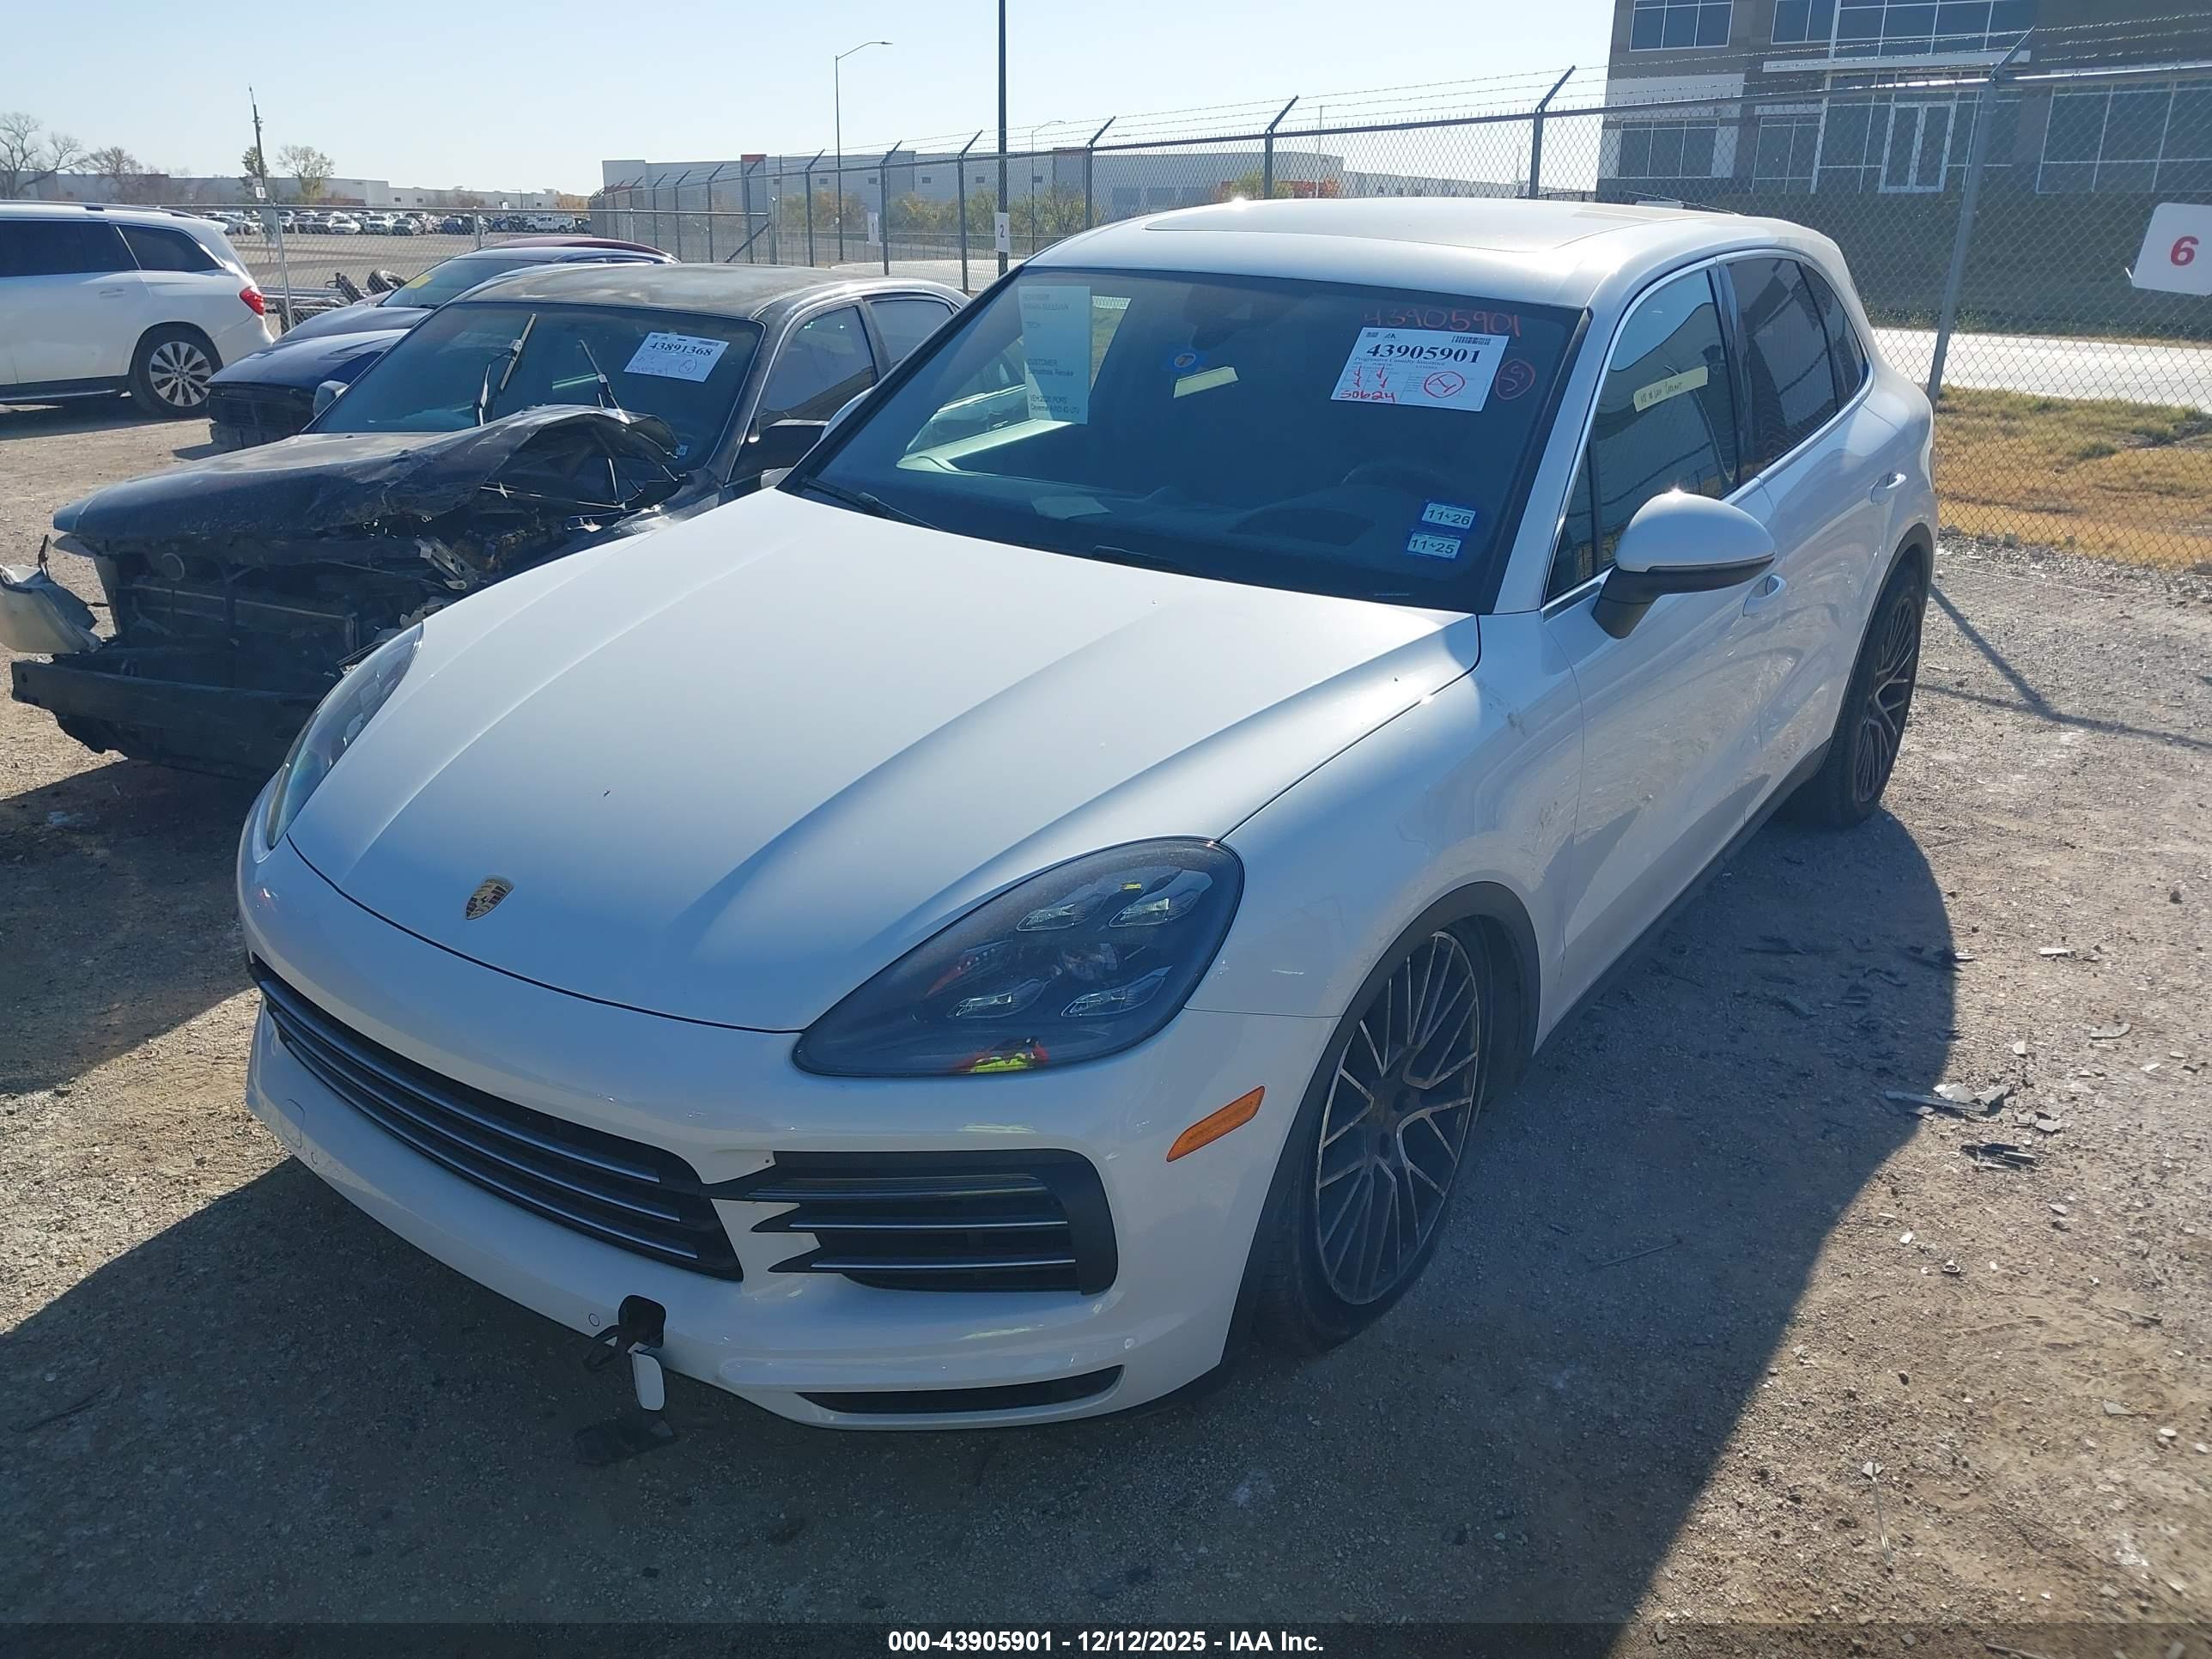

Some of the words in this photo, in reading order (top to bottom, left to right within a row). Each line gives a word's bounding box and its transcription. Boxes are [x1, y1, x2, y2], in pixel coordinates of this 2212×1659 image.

[1000, 224, 1005, 238] 2
[2170, 235, 2199, 266] 6
[1363, 308, 1521, 337] 43905901
[648, 342, 714, 357] 43891368
[1366, 343, 1482, 364] 43905901
